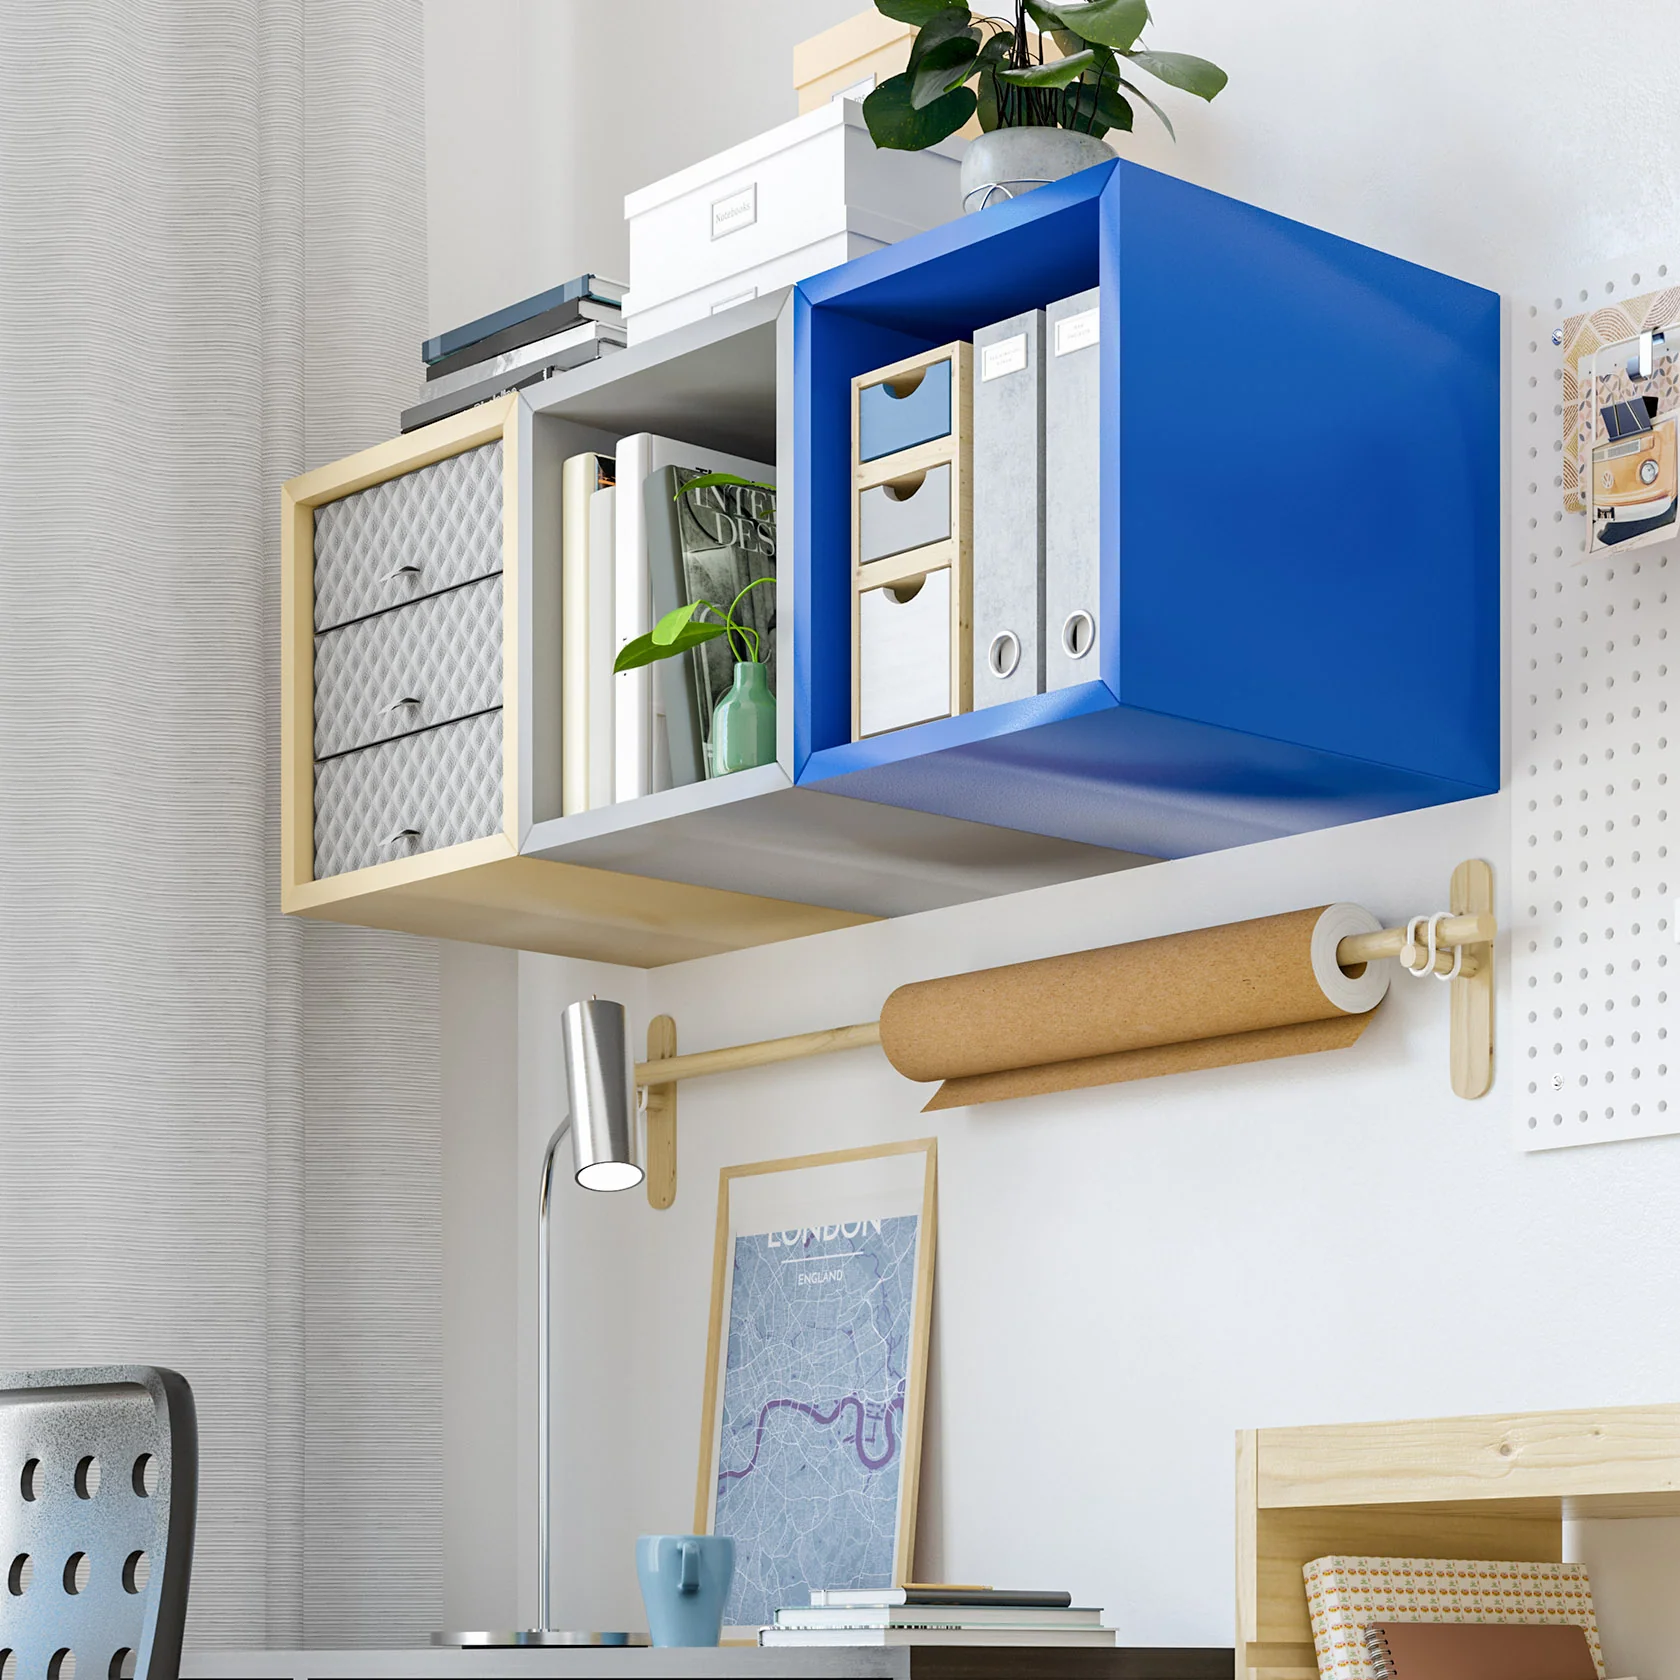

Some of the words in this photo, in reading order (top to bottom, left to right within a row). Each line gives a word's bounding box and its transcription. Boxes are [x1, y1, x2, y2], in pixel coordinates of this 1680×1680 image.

[715, 201, 751, 224] Notebooks
[711, 511, 776, 557] DES
[767, 1219, 882, 1248] LONDON
[798, 1269, 844, 1286] ENGLAND
